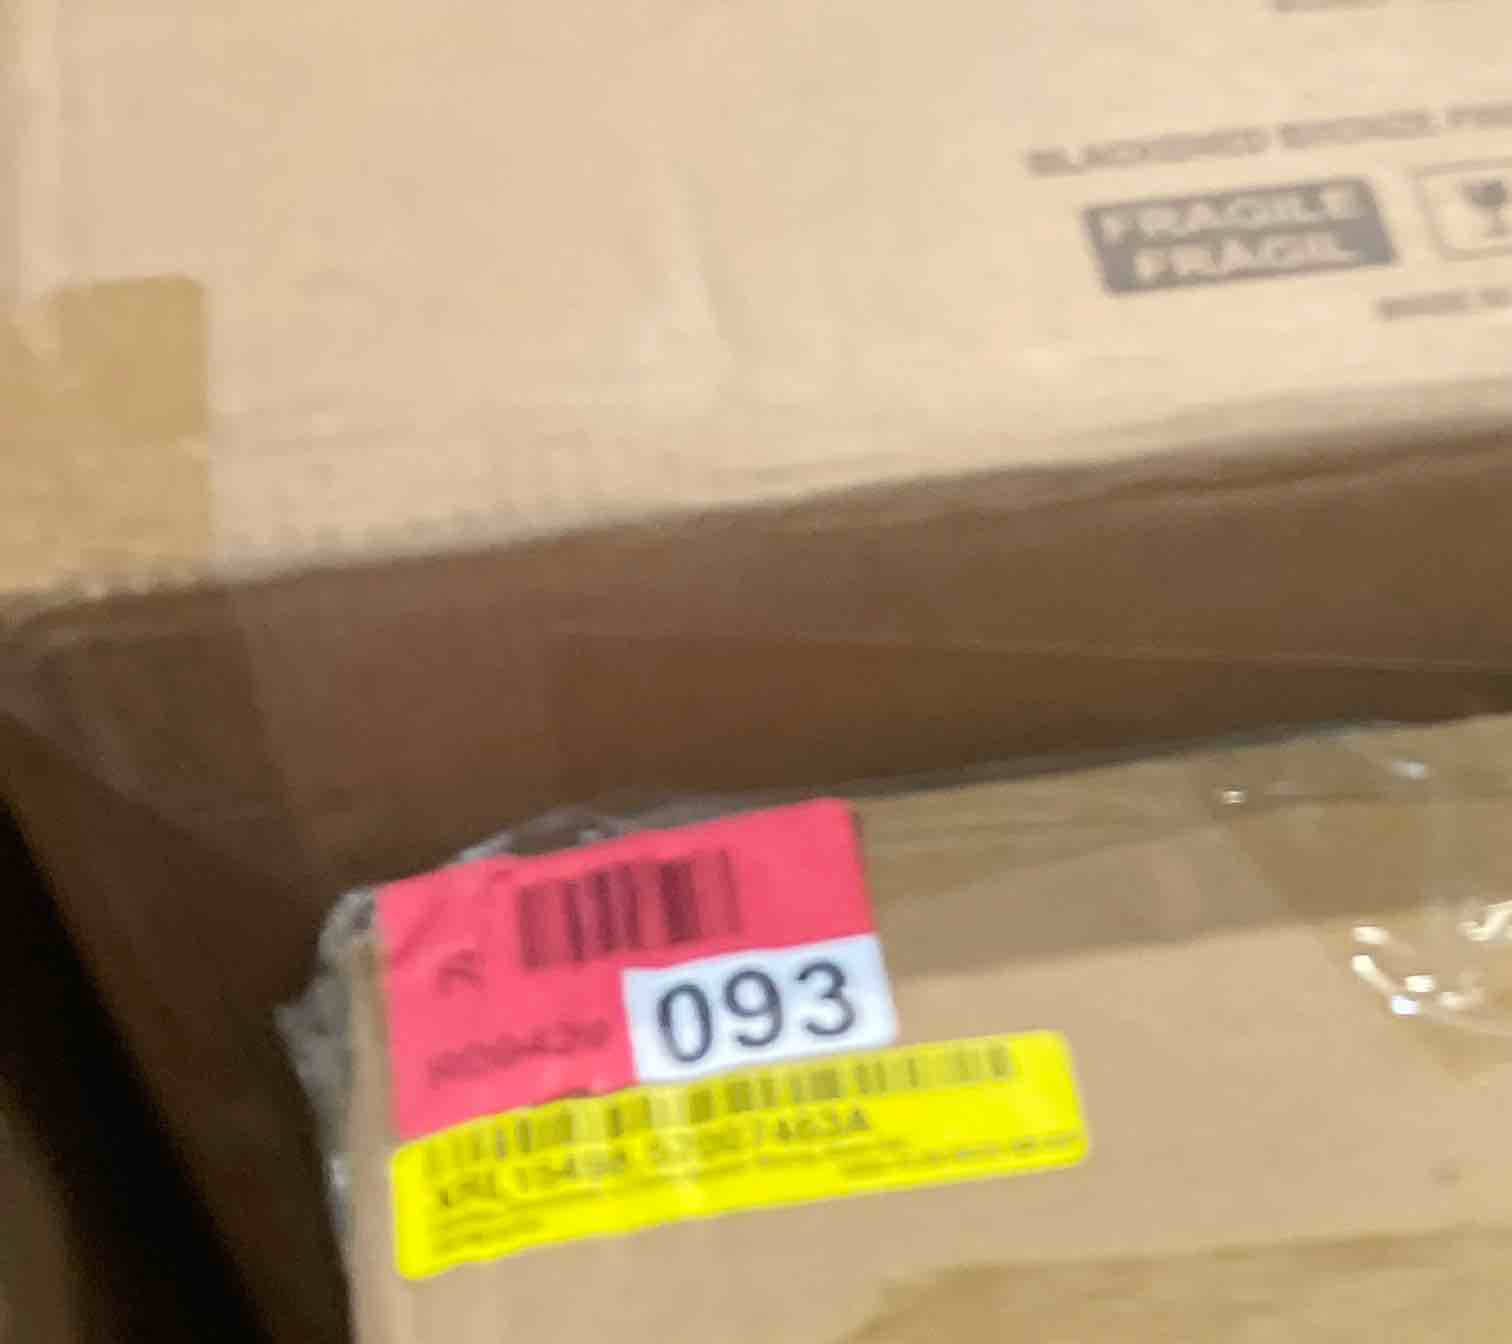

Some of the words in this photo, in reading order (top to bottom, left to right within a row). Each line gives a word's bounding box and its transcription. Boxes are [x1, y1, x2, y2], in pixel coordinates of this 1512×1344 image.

[1102, 182, 1360, 244] FRAGILE
[1134, 229, 1362, 283] FRAGIL
[654, 960, 857, 1064] 093
